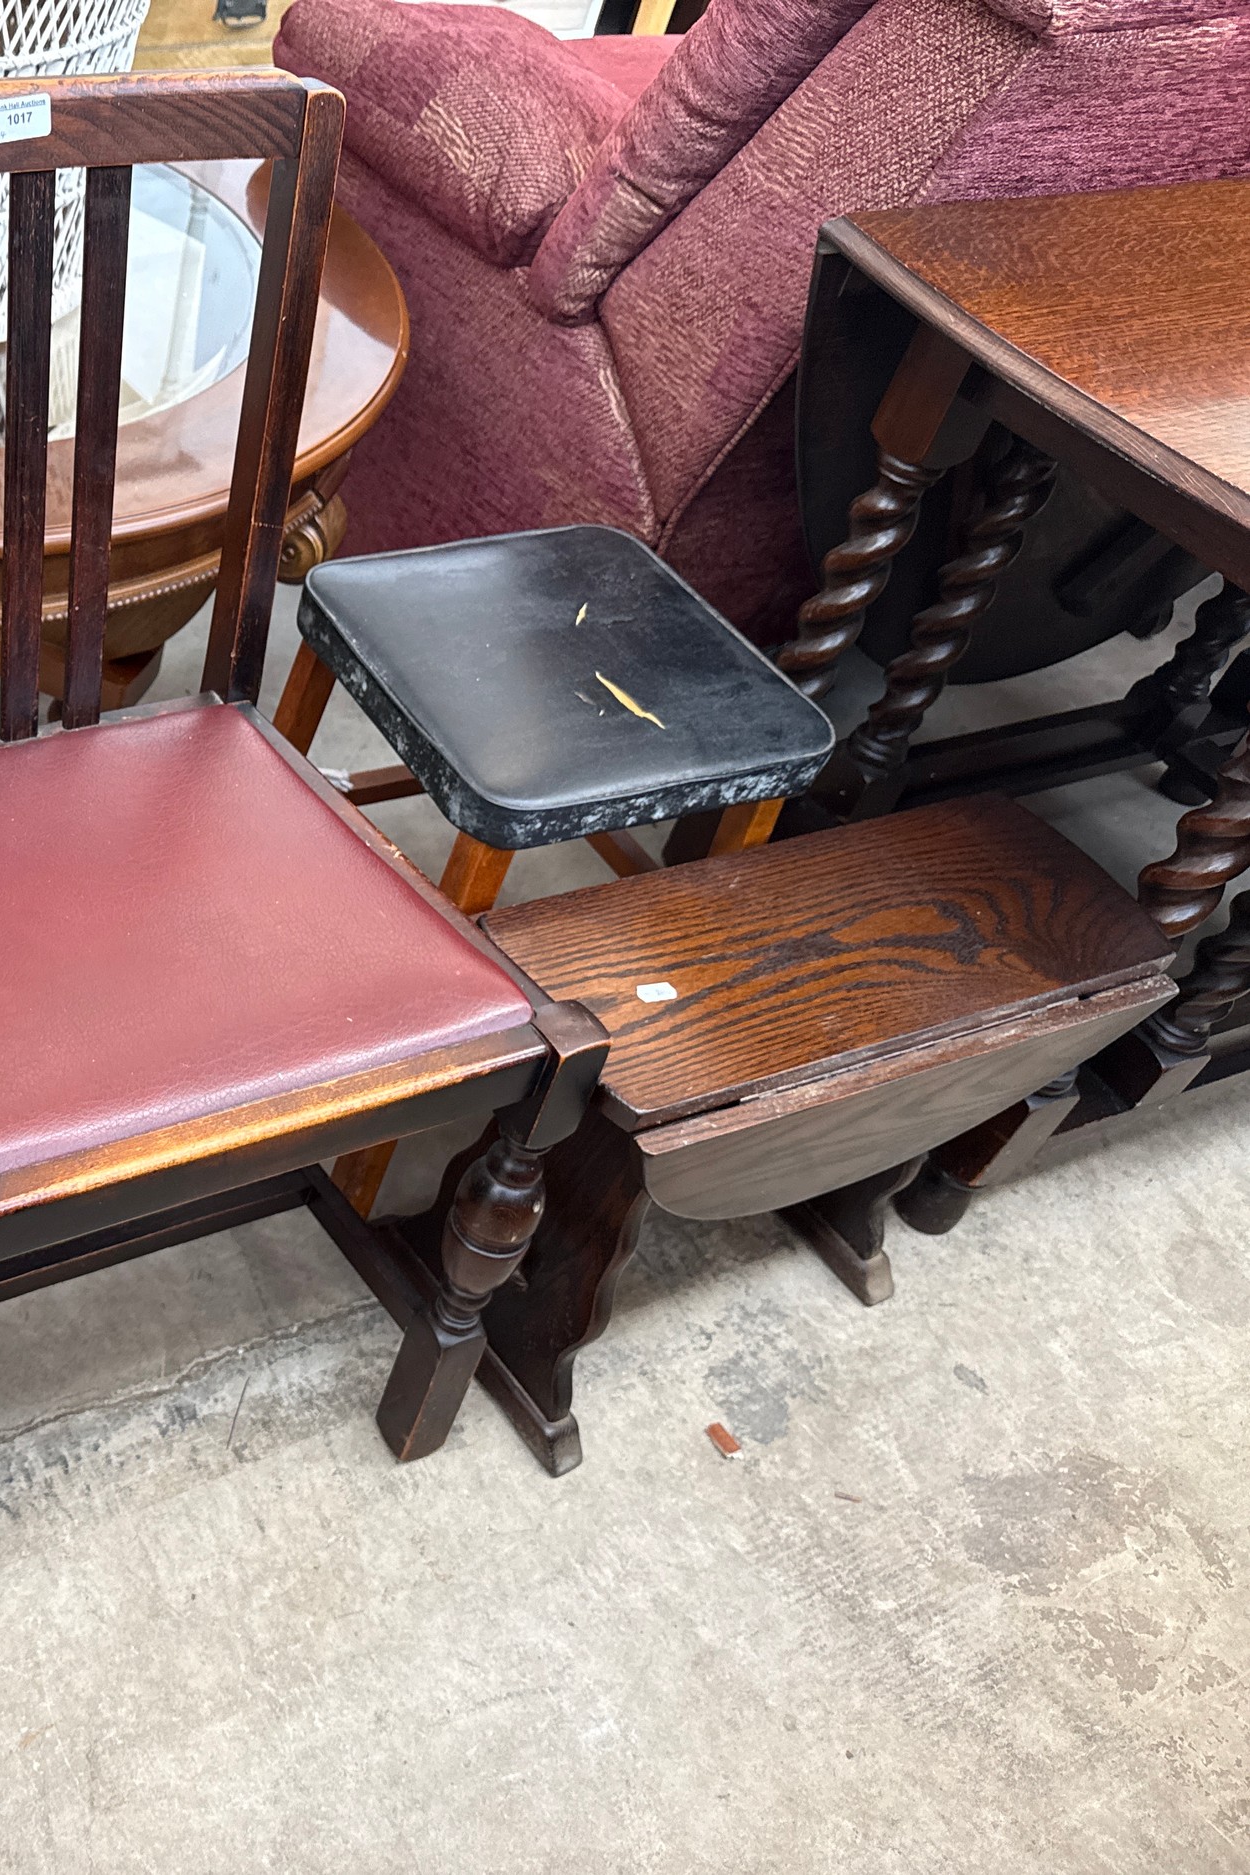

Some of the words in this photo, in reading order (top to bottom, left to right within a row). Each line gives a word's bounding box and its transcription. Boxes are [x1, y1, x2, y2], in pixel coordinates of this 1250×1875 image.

[9, 102, 19, 110] Hall
[21, 99, 46, 108] Auctions
[7, 111, 32, 126] 1017
